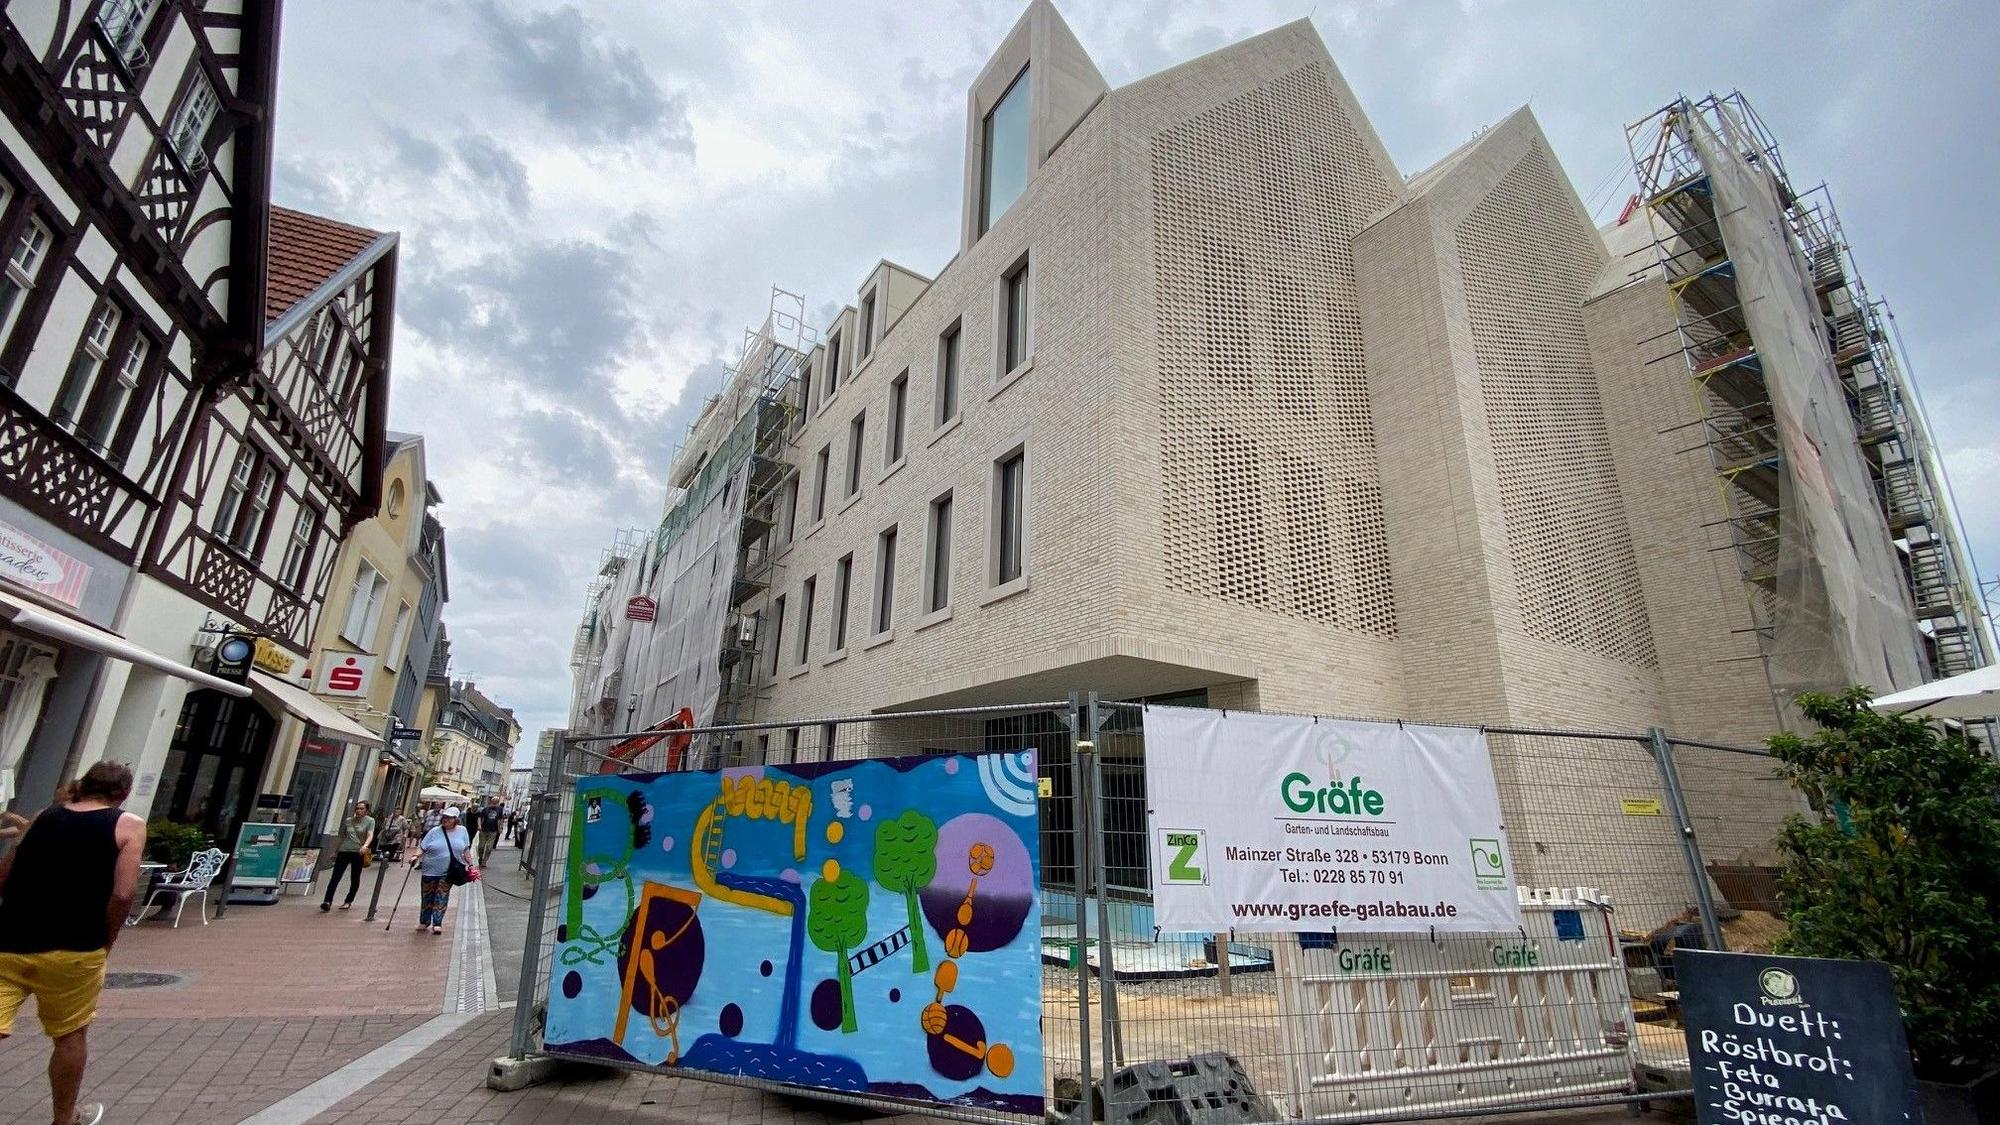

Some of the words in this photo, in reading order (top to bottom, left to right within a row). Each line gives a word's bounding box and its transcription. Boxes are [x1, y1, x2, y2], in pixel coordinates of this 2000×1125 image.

[1281, 772, 1384, 816] Gräfe
[1167, 834, 1198, 846] ZinCo
[1285, 823, 1313, 835] Garten-
[1315, 825, 1329, 835] und
[1331, 825, 1389, 837] Landschaftsbau
[1226, 846, 1281, 861] Mainzer
[1286, 848, 1331, 862] Straße
[1335, 849, 1359, 863] 328
[1372, 850, 1410, 864] 53179
[1414, 851, 1449, 865] Bonn
[1280, 868, 1309, 883] Tel.:
[1313, 869, 1346, 884] 0228
[1350, 870, 1366, 884] 85
[1369, 870, 1385, 884] 70
[1389, 870, 1404, 884] 91
[1232, 900, 1457, 921] www.graefe-galabau.de
[1339, 948, 1392, 971] Gräfe
[1493, 945, 1539, 967] Gräfe
[1733, 1003, 1841, 1040] Duett:
[1701, 1030, 1853, 1080] Röstbrot:
